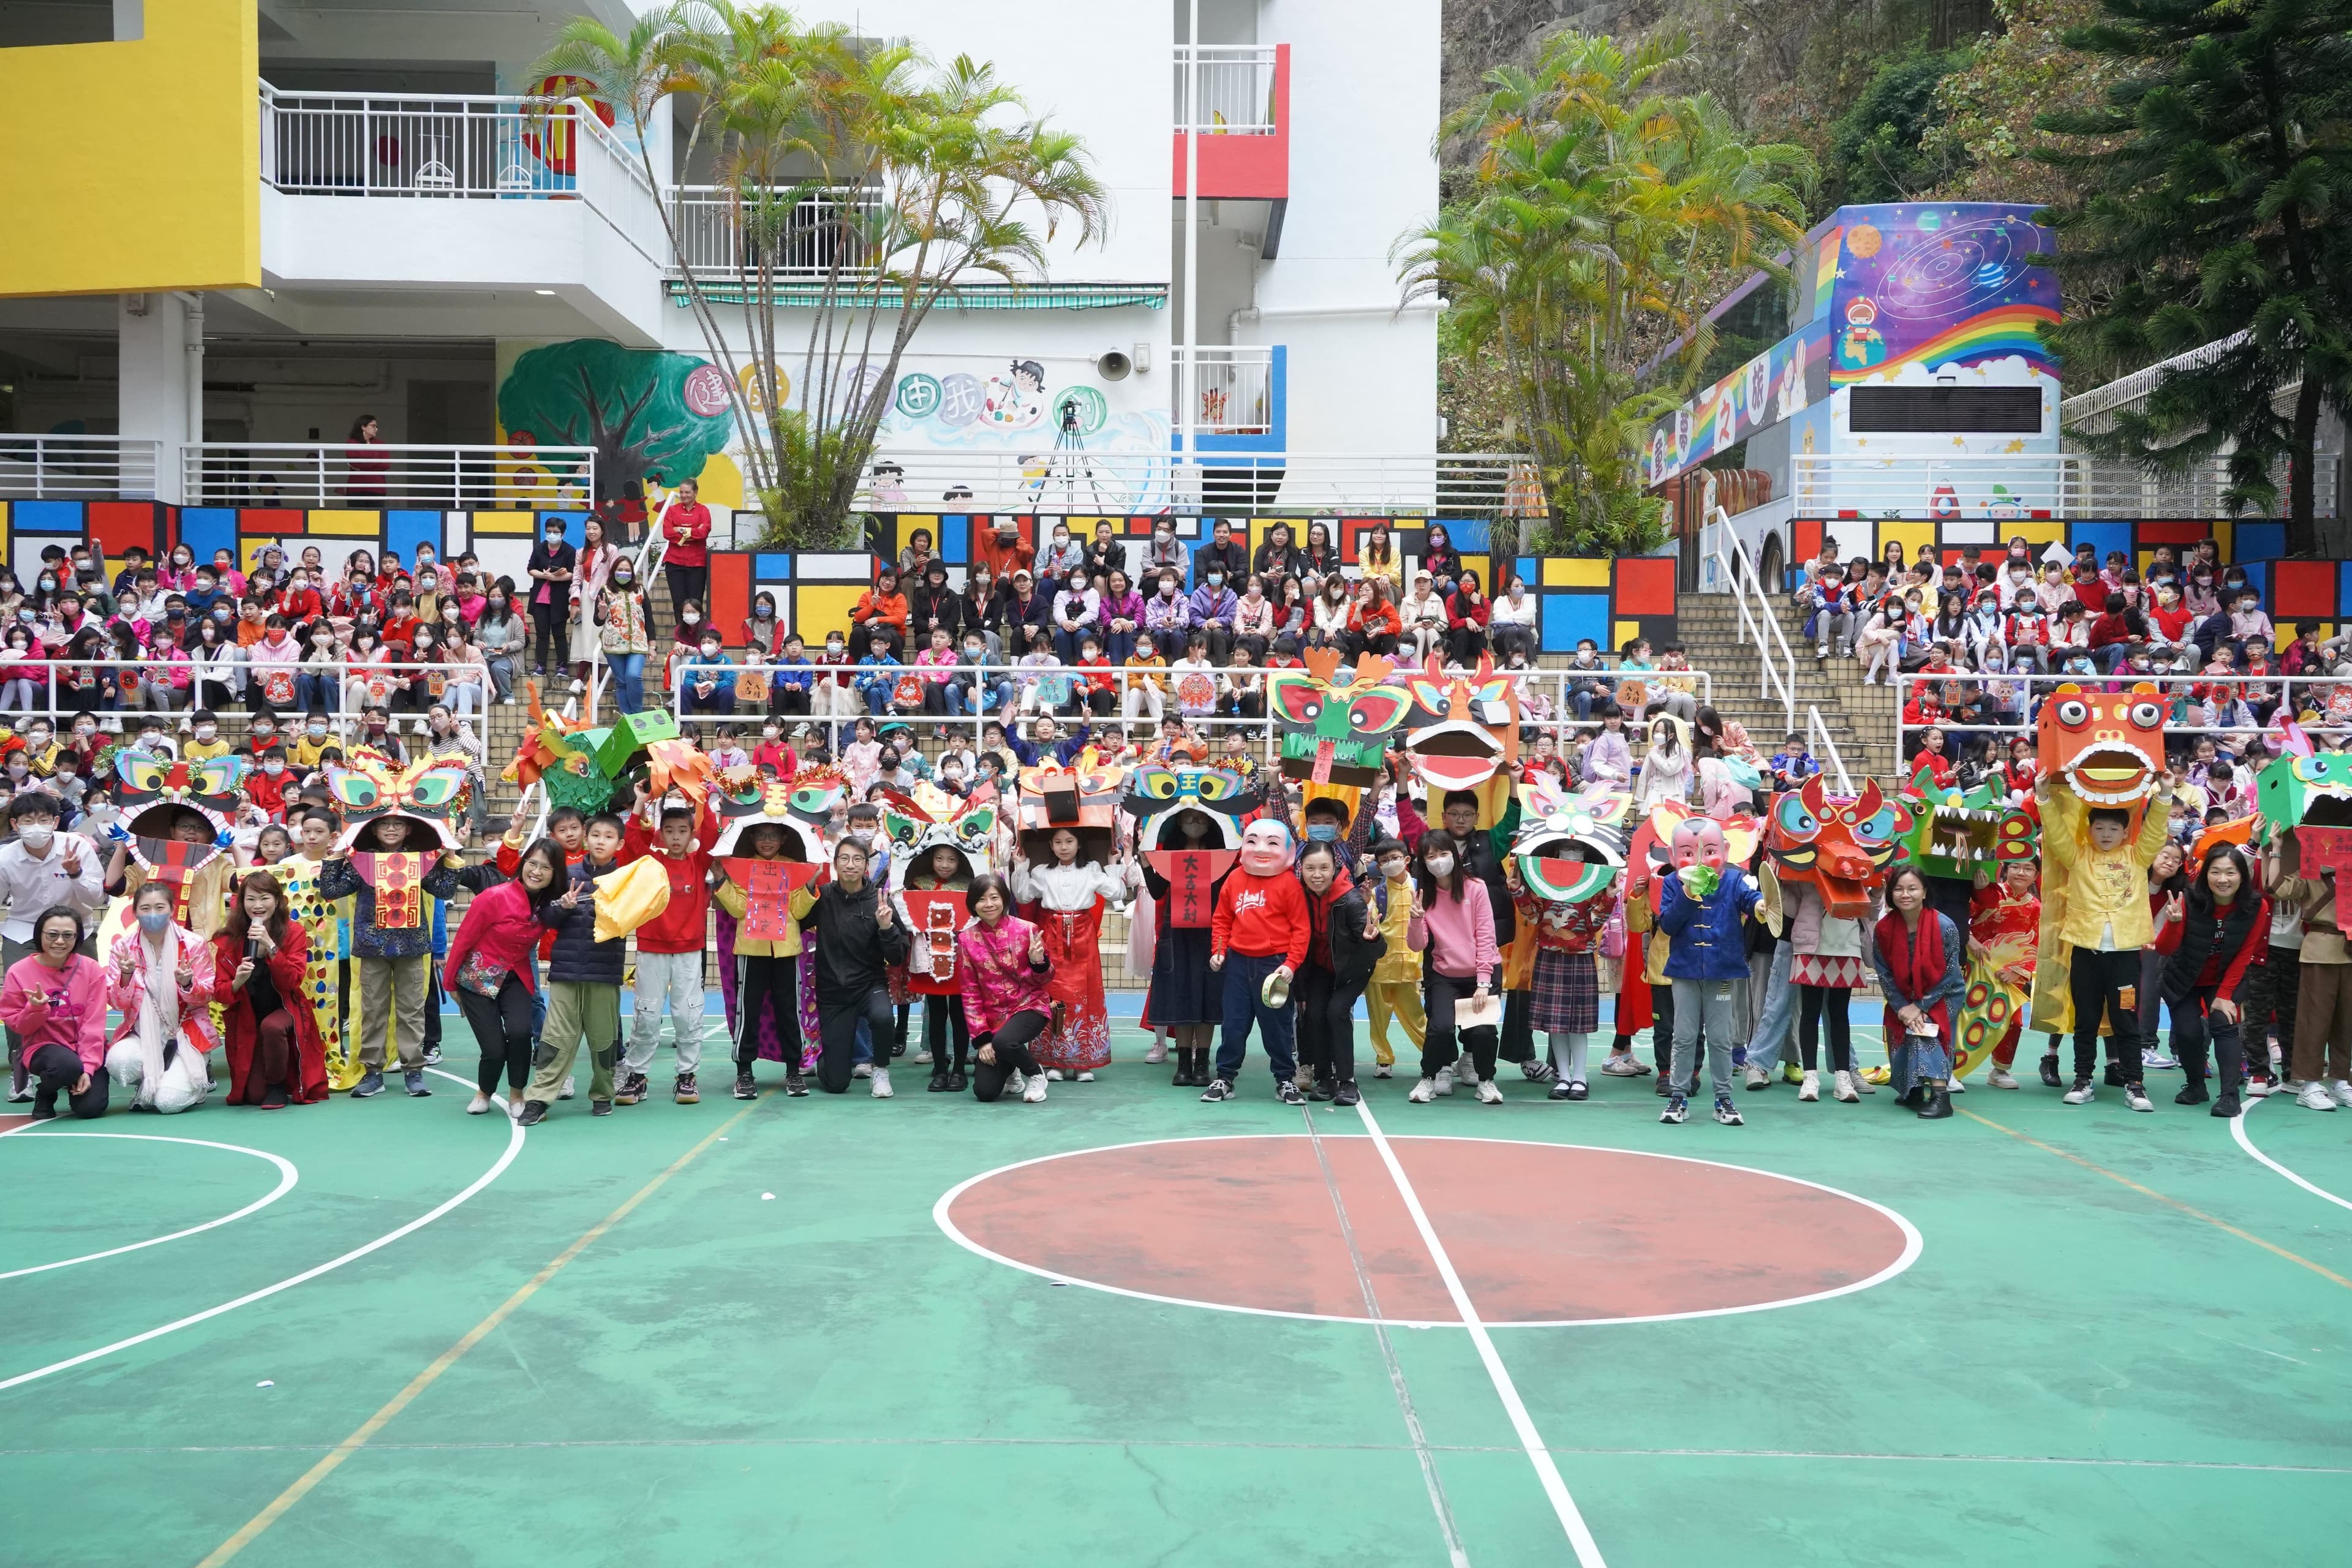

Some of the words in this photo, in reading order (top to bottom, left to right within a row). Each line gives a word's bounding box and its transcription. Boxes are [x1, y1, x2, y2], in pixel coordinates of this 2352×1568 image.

[1654, 361, 1765, 481] 童夢之旅
[765, 784, 787, 804] 王
[1182, 775, 1197, 790] 王
[390, 854, 405, 921] 身體健康
[760, 861, 777, 932] 出入平安
[1182, 854, 1199, 924] 大吉大利
